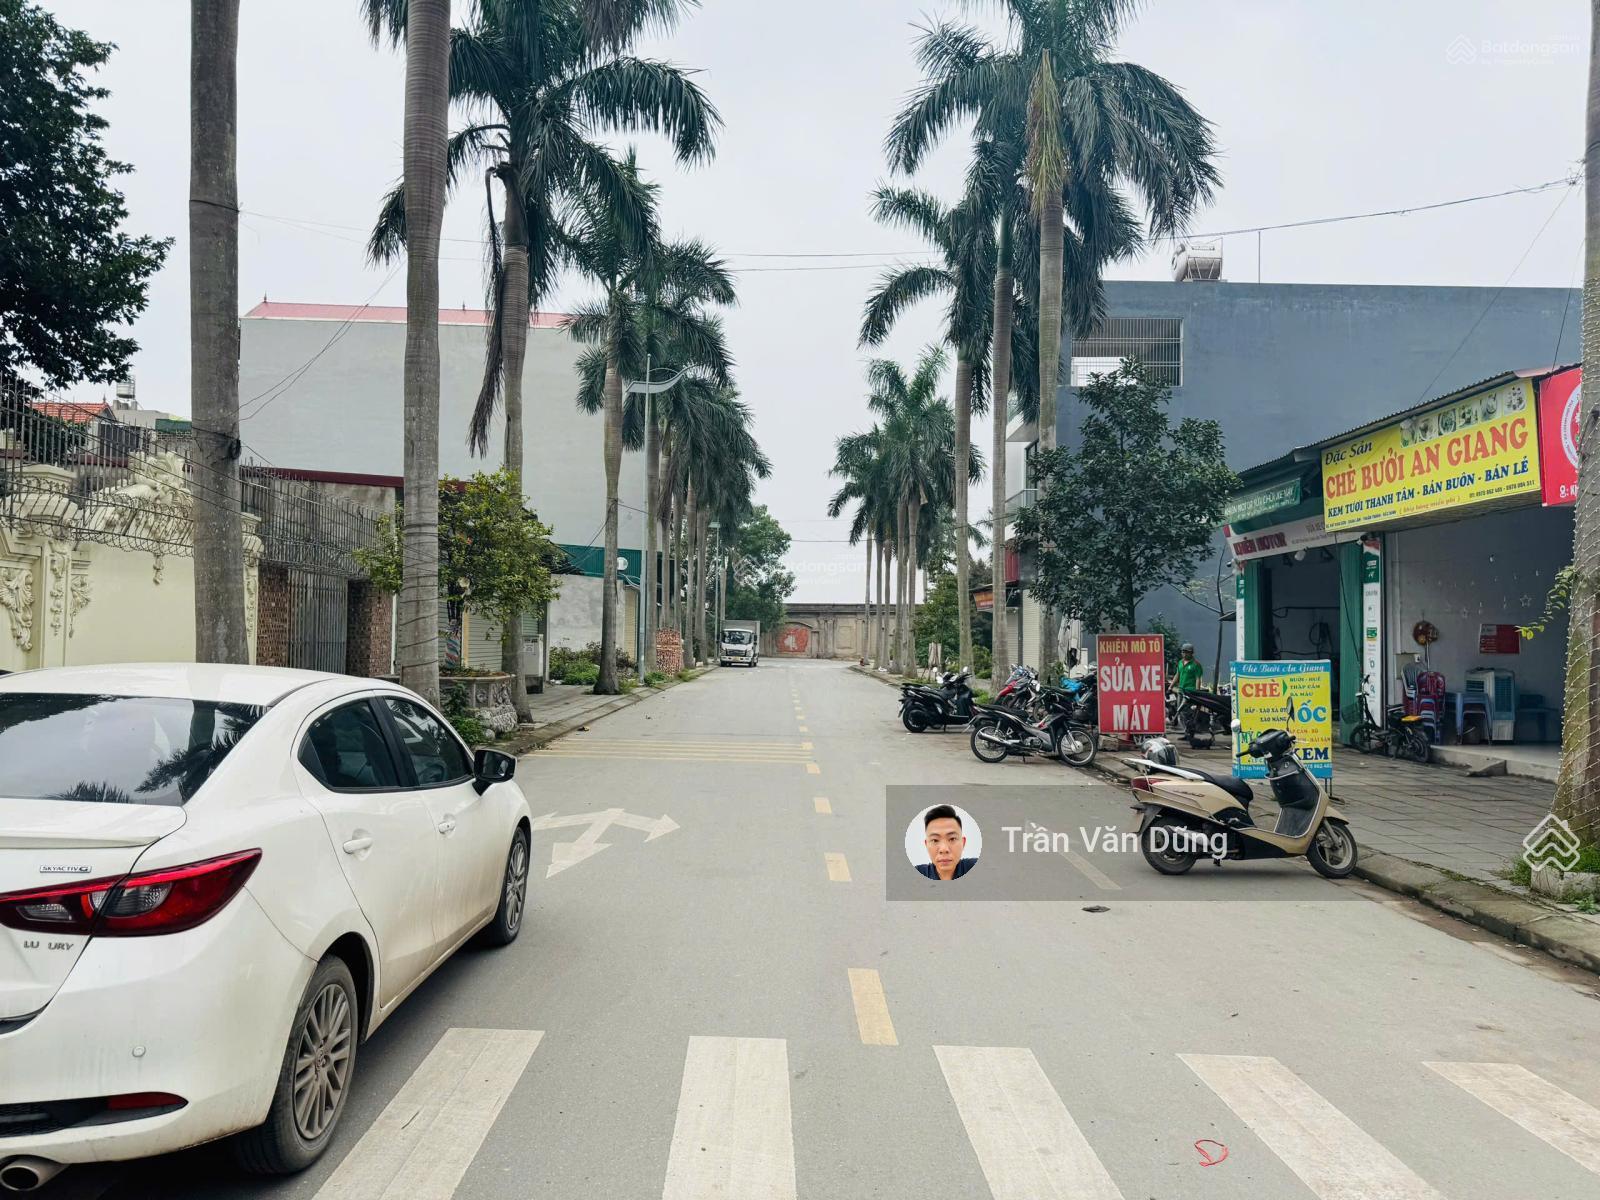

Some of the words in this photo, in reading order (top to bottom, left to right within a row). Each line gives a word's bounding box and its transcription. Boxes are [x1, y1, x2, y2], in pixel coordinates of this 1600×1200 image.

[1324, 450, 1347, 467] Đặc
[1349, 438, 1373, 459] Sản
[1325, 462, 1357, 499] CHÈ
[1361, 447, 1406, 492] BƯỞI
[1410, 446, 1443, 476] AN
[1447, 417, 1529, 467] GIANG
[1327, 504, 1344, 519] KEM
[1364, 493, 1395, 512] THANH
[1394, 486, 1416, 506] TÂM
[1421, 479, 1444, 497] BÁN
[1445, 471, 1476, 492] BUÔN
[1484, 462, 1510, 482] BÁN
[1511, 455, 1530, 475] LẺ
[1099, 640, 1129, 653] KHIÊN
[1130, 639, 1147, 653] MÔ
[1149, 639, 1161, 653] TÔ
[1100, 657, 1135, 693] SỬA
[1140, 664, 1162, 692] XE
[1241, 679, 1281, 698] CHÈ
[1112, 699, 1151, 731] MÁY
[1297, 699, 1327, 723] ỐC
